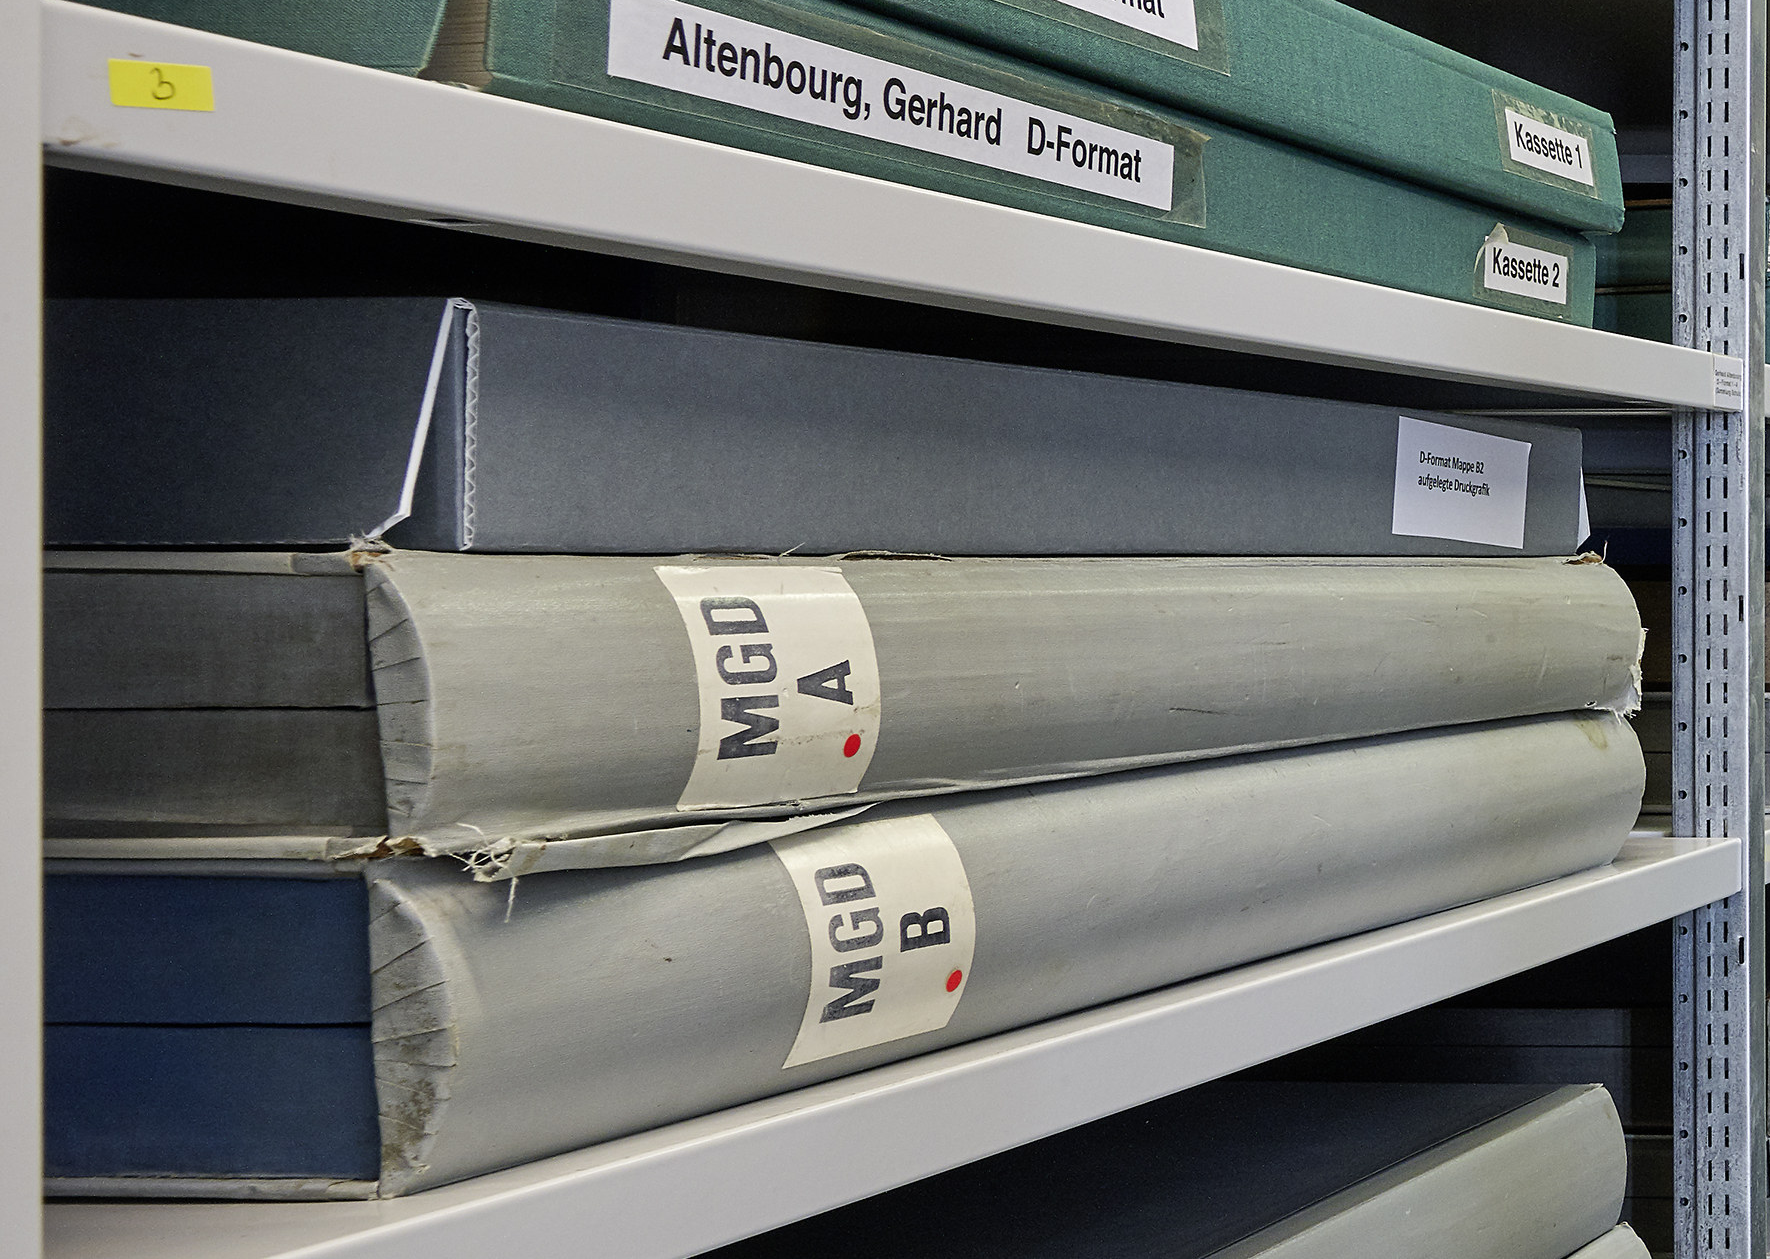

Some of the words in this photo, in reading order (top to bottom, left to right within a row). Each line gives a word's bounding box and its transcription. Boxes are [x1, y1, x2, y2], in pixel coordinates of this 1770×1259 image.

[150, 67, 176, 101] 3
[662, 17, 871, 122] Altenbourg,
[883, 77, 1003, 147] Gerhard
[1027, 116, 1142, 184] D-Format
[1514, 121, 1573, 166] Kassette
[1575, 144, 1582, 169] 1
[1493, 247, 1550, 286] Kassette
[1552, 262, 1560, 288] 2
[1418, 473, 1453, 493] aufgelegte
[1454, 478, 1490, 497] Druckgrafik
[1419, 450, 1452, 469] D-Format
[1452, 456, 1475, 474] Mappe
[1476, 461, 1485, 475] B2
[701, 596, 780, 761] MGD
[797, 659, 855, 707] A
[814, 862, 885, 1024] MGD
[900, 905, 951, 953] B
